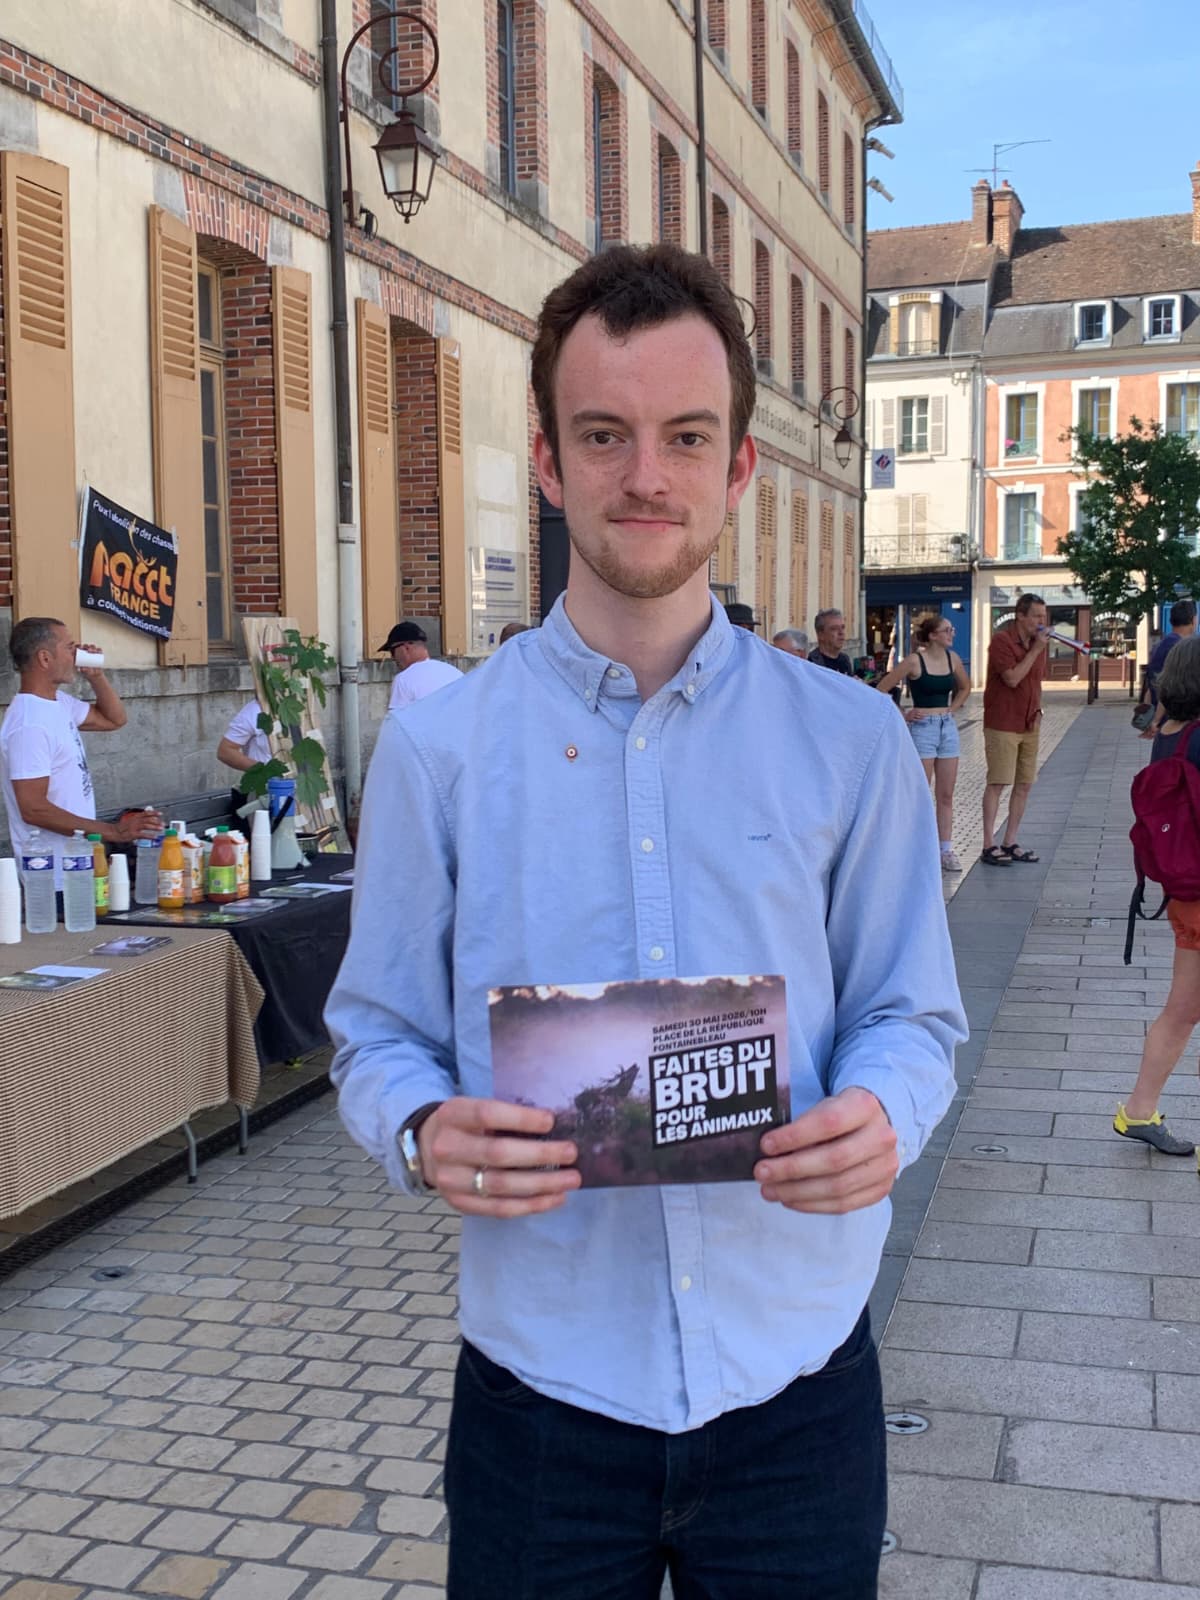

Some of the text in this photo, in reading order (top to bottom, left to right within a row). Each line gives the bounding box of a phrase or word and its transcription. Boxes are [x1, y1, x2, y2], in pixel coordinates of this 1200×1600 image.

[652, 1022, 688, 1034] SAMEDI
[689, 1019, 701, 1028] 30
[703, 1015, 720, 1025] MAI
[653, 1032, 681, 1043] PLACE
[697, 1026, 708, 1034] LA
[709, 1017, 765, 1032] RÉPUBLIQUE
[653, 1033, 726, 1052] FONTAINEBLEAU
[653, 1039, 771, 1079] FAITES DU
[655, 1059, 772, 1111] BRUIT
[655, 1105, 706, 1128] POUR
[656, 1107, 773, 1145] LES ANIMAUX
